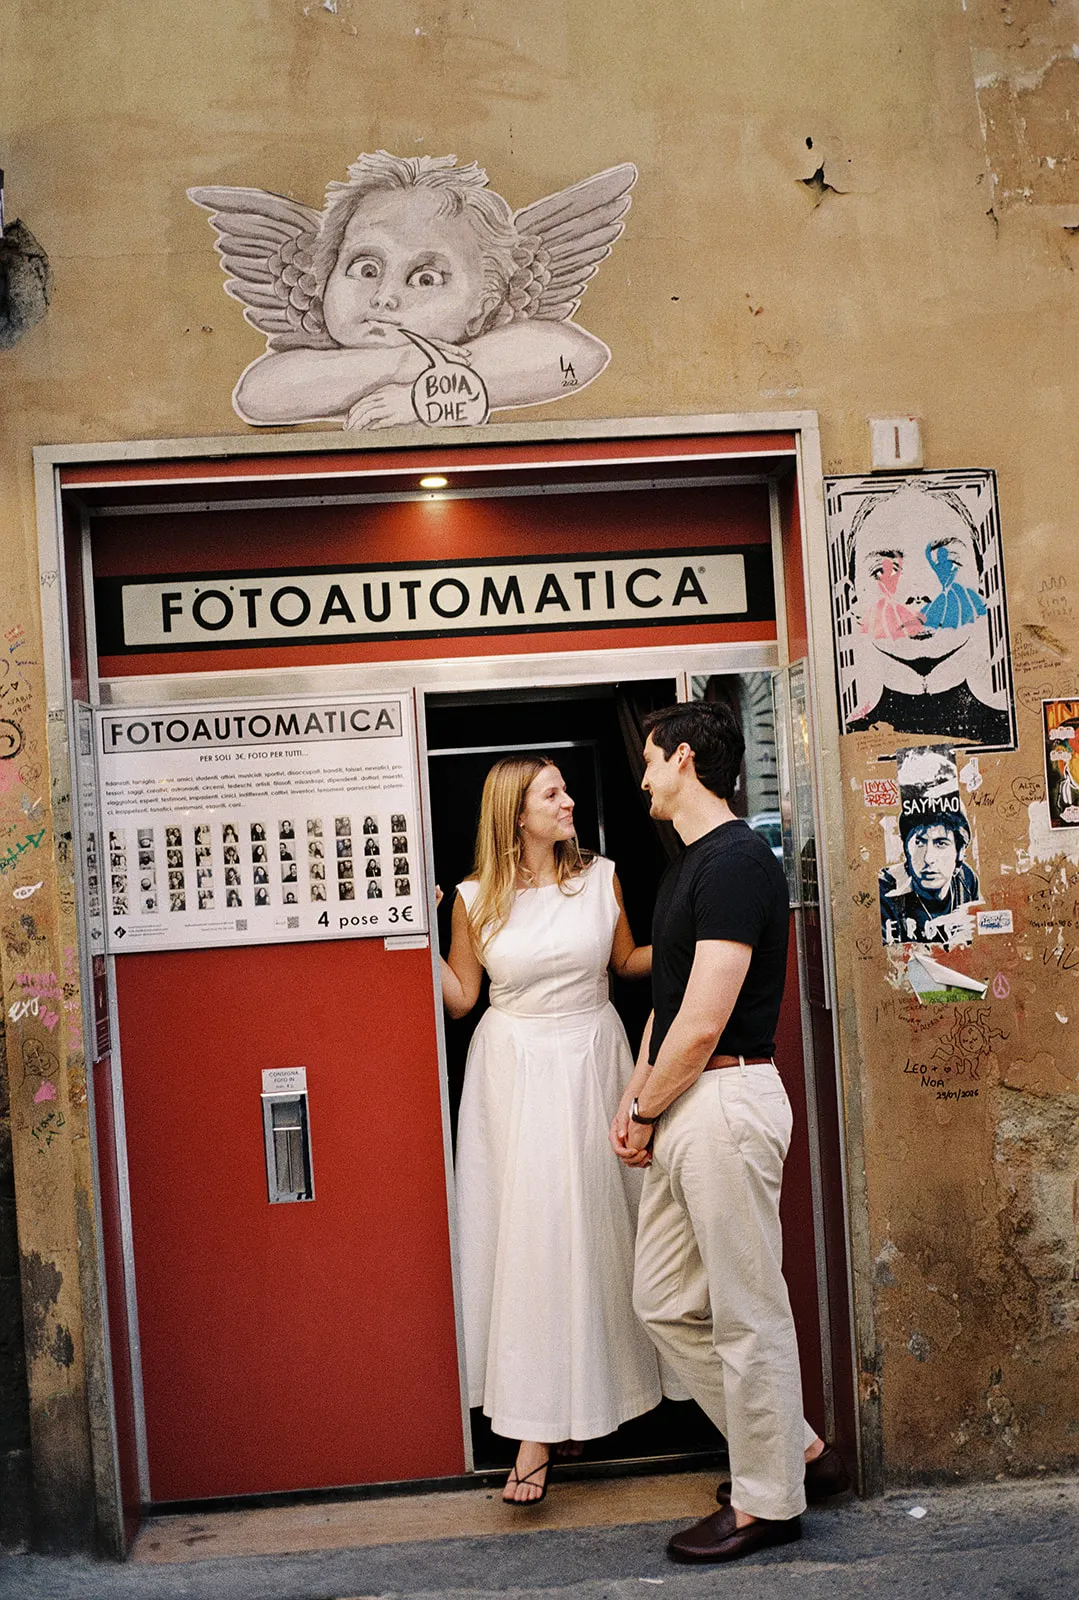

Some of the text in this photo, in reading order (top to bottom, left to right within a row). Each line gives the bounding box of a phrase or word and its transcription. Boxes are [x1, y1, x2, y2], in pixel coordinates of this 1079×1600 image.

[425, 402, 468, 424] DHE
[111, 708, 395, 746] FOTOAUTOMATICA
[214, 754, 231, 762] SOLI
[248, 752, 268, 760] FOTO
[318, 905, 414, 929] 4 pose 3€
[903, 1058, 928, 1074] LEO
[921, 1076, 945, 1087] NOA
